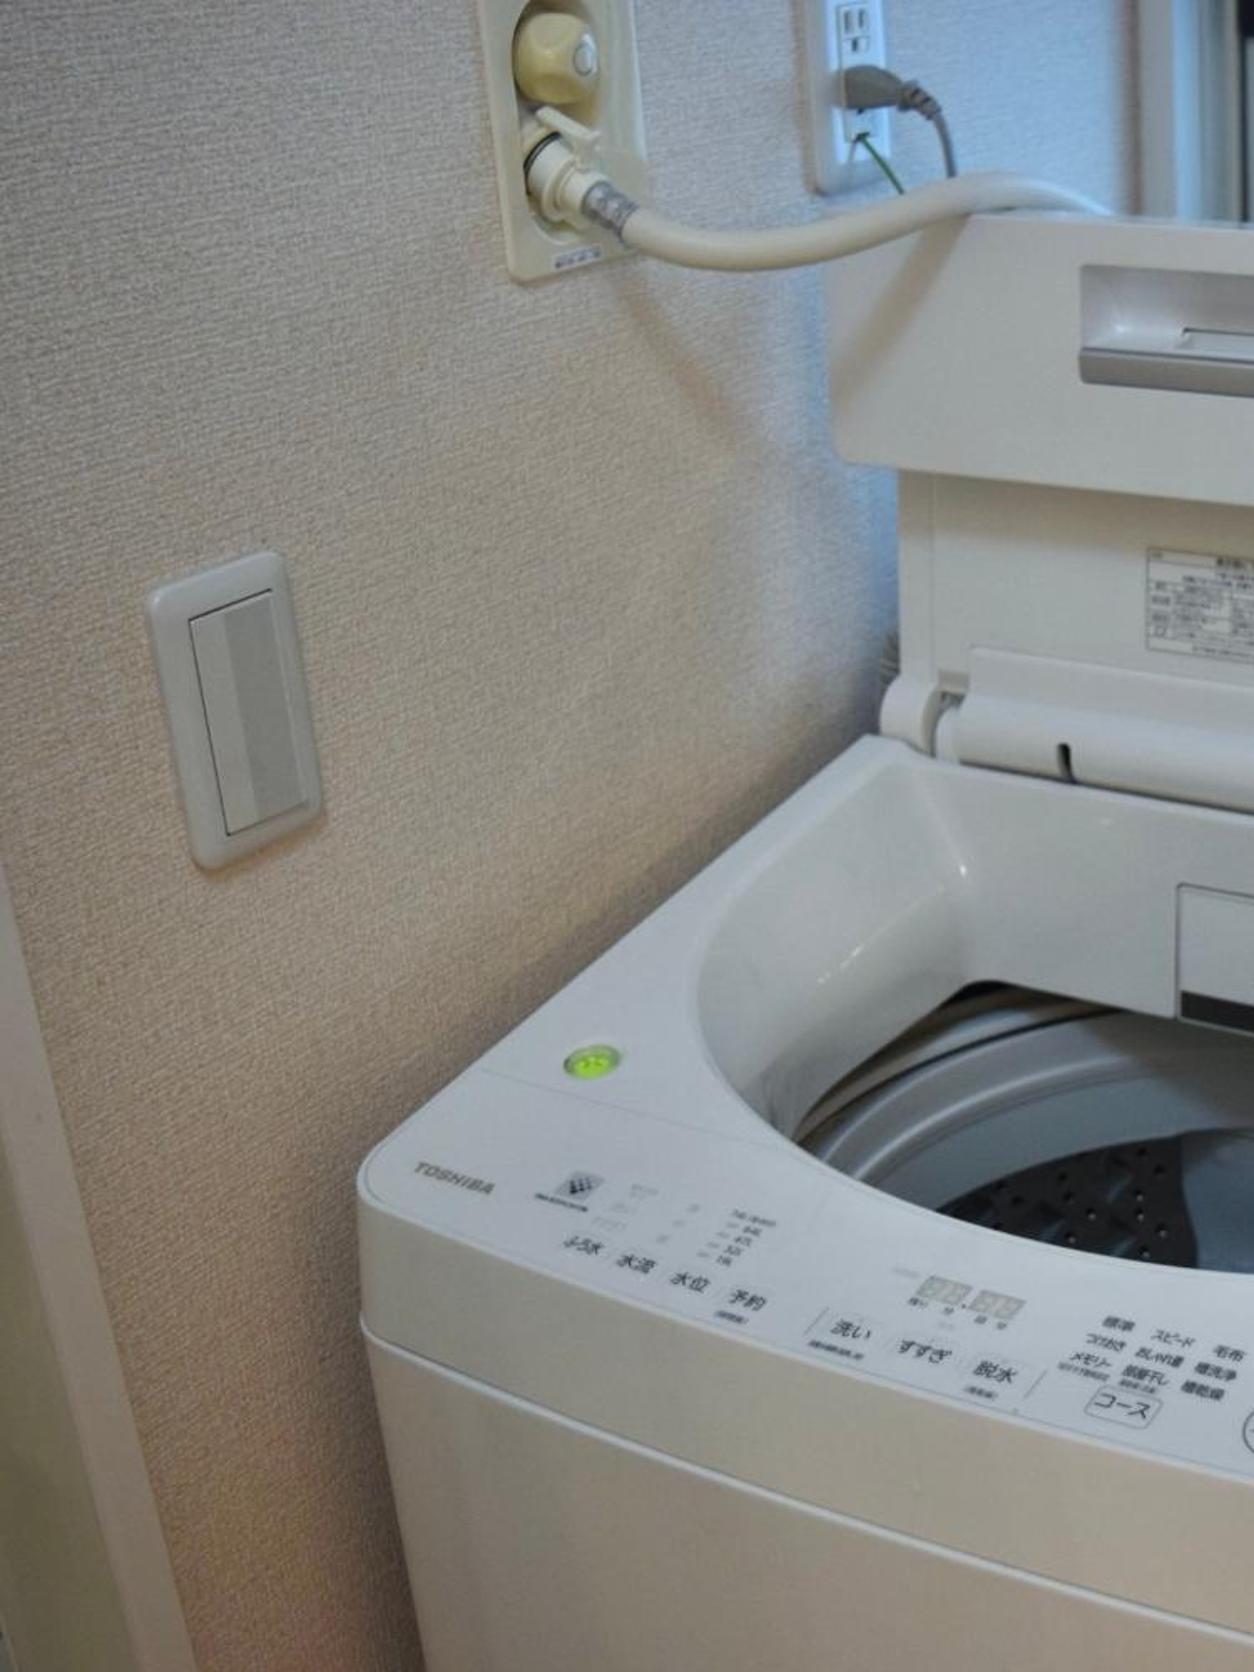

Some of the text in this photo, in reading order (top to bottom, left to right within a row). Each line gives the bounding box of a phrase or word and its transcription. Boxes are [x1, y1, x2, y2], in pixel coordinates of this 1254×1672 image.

[413, 1161, 495, 1195] TOSHIBA
[563, 1234, 606, 1257] ふろ水
[616, 1252, 658, 1275] 水流
[669, 1271, 710, 1295] 水位
[728, 1288, 768, 1313] 予約
[829, 1318, 872, 1341] 洗い
[1150, 1329, 1196, 1350] スピード
[897, 1339, 953, 1364] すすぎ
[1068, 1350, 1113, 1369] メモリー
[1212, 1343, 1248, 1362] 毛布
[973, 1359, 1019, 1385] 脱水
[1120, 1364, 1171, 1387] 部屋干し
[1093, 1391, 1152, 1421] コース
